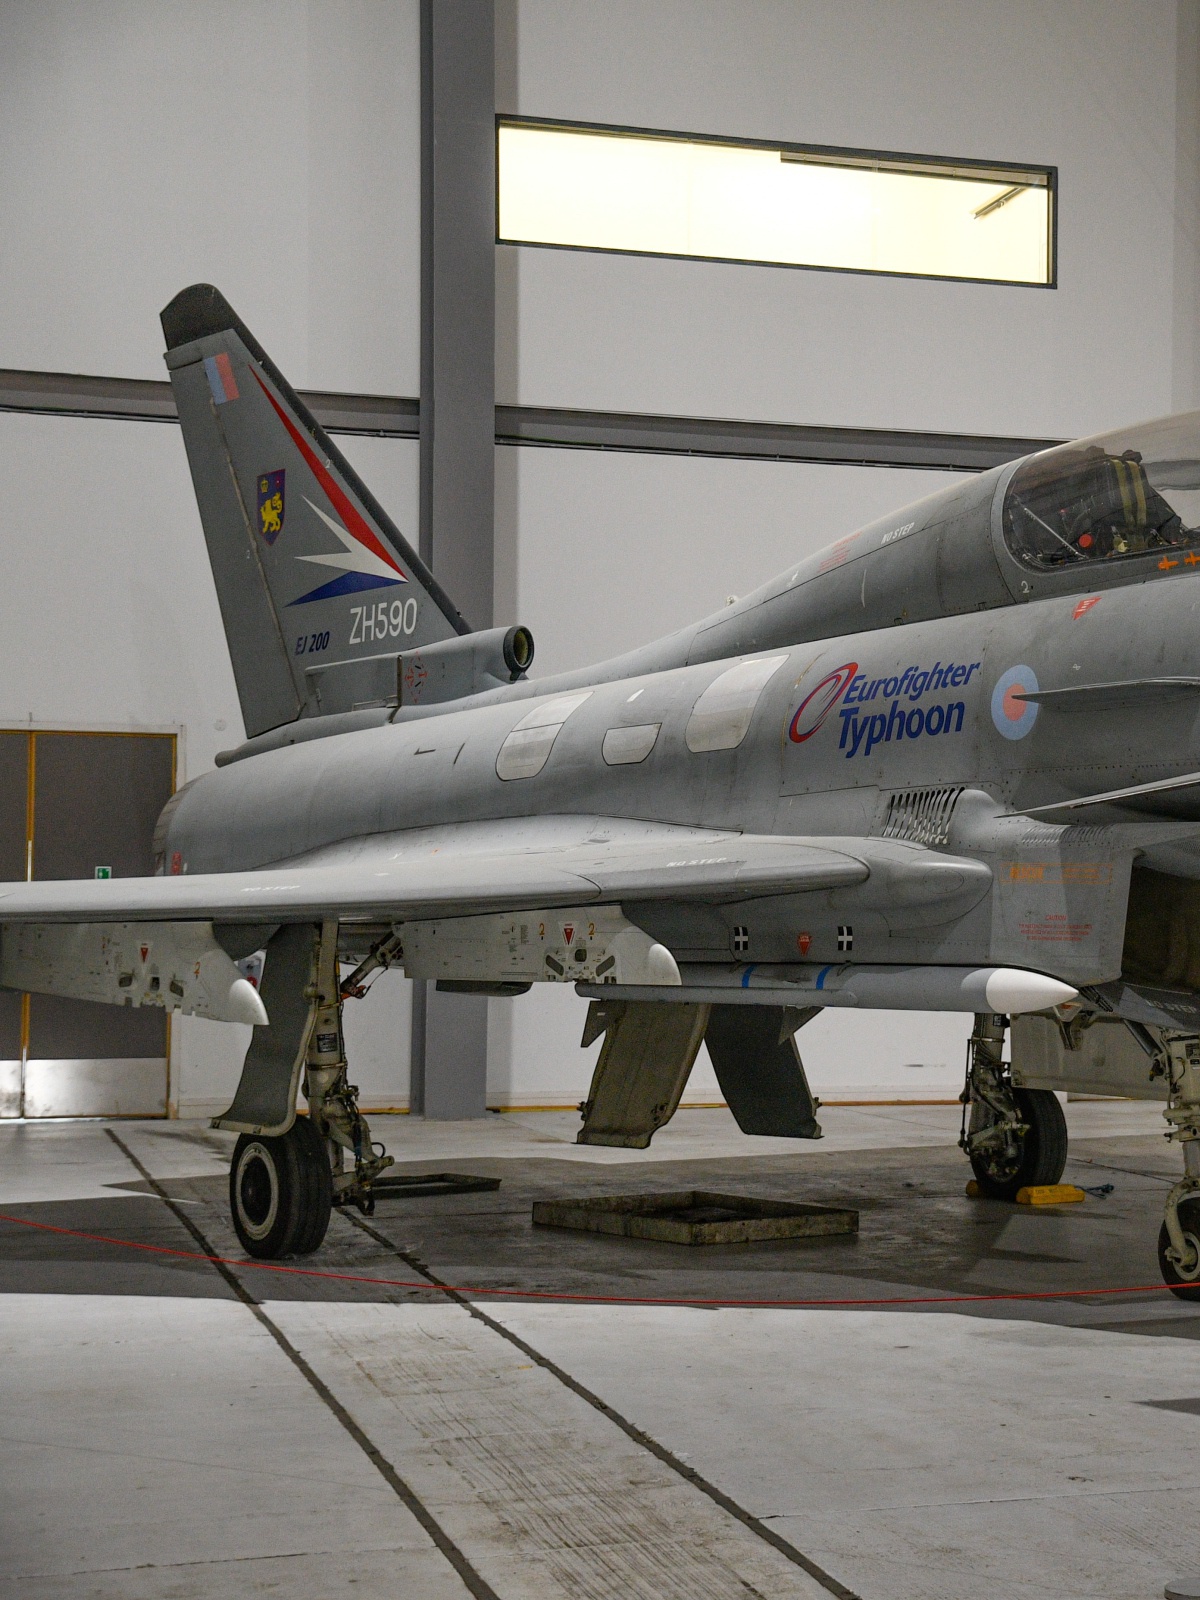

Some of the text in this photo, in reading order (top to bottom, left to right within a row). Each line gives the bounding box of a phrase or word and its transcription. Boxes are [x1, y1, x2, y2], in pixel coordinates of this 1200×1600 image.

[881, 522, 915, 544] NO STEP
[1021, 581, 1030, 593] 2
[349, 597, 418, 645] ZH590
[295, 631, 330, 656] EJ 200
[842, 661, 981, 704] Eurofighter
[838, 700, 965, 759] Typhoon
[666, 857, 727, 868] NO STEP
[539, 923, 545, 936] 2
[588, 922, 595, 936] 2
